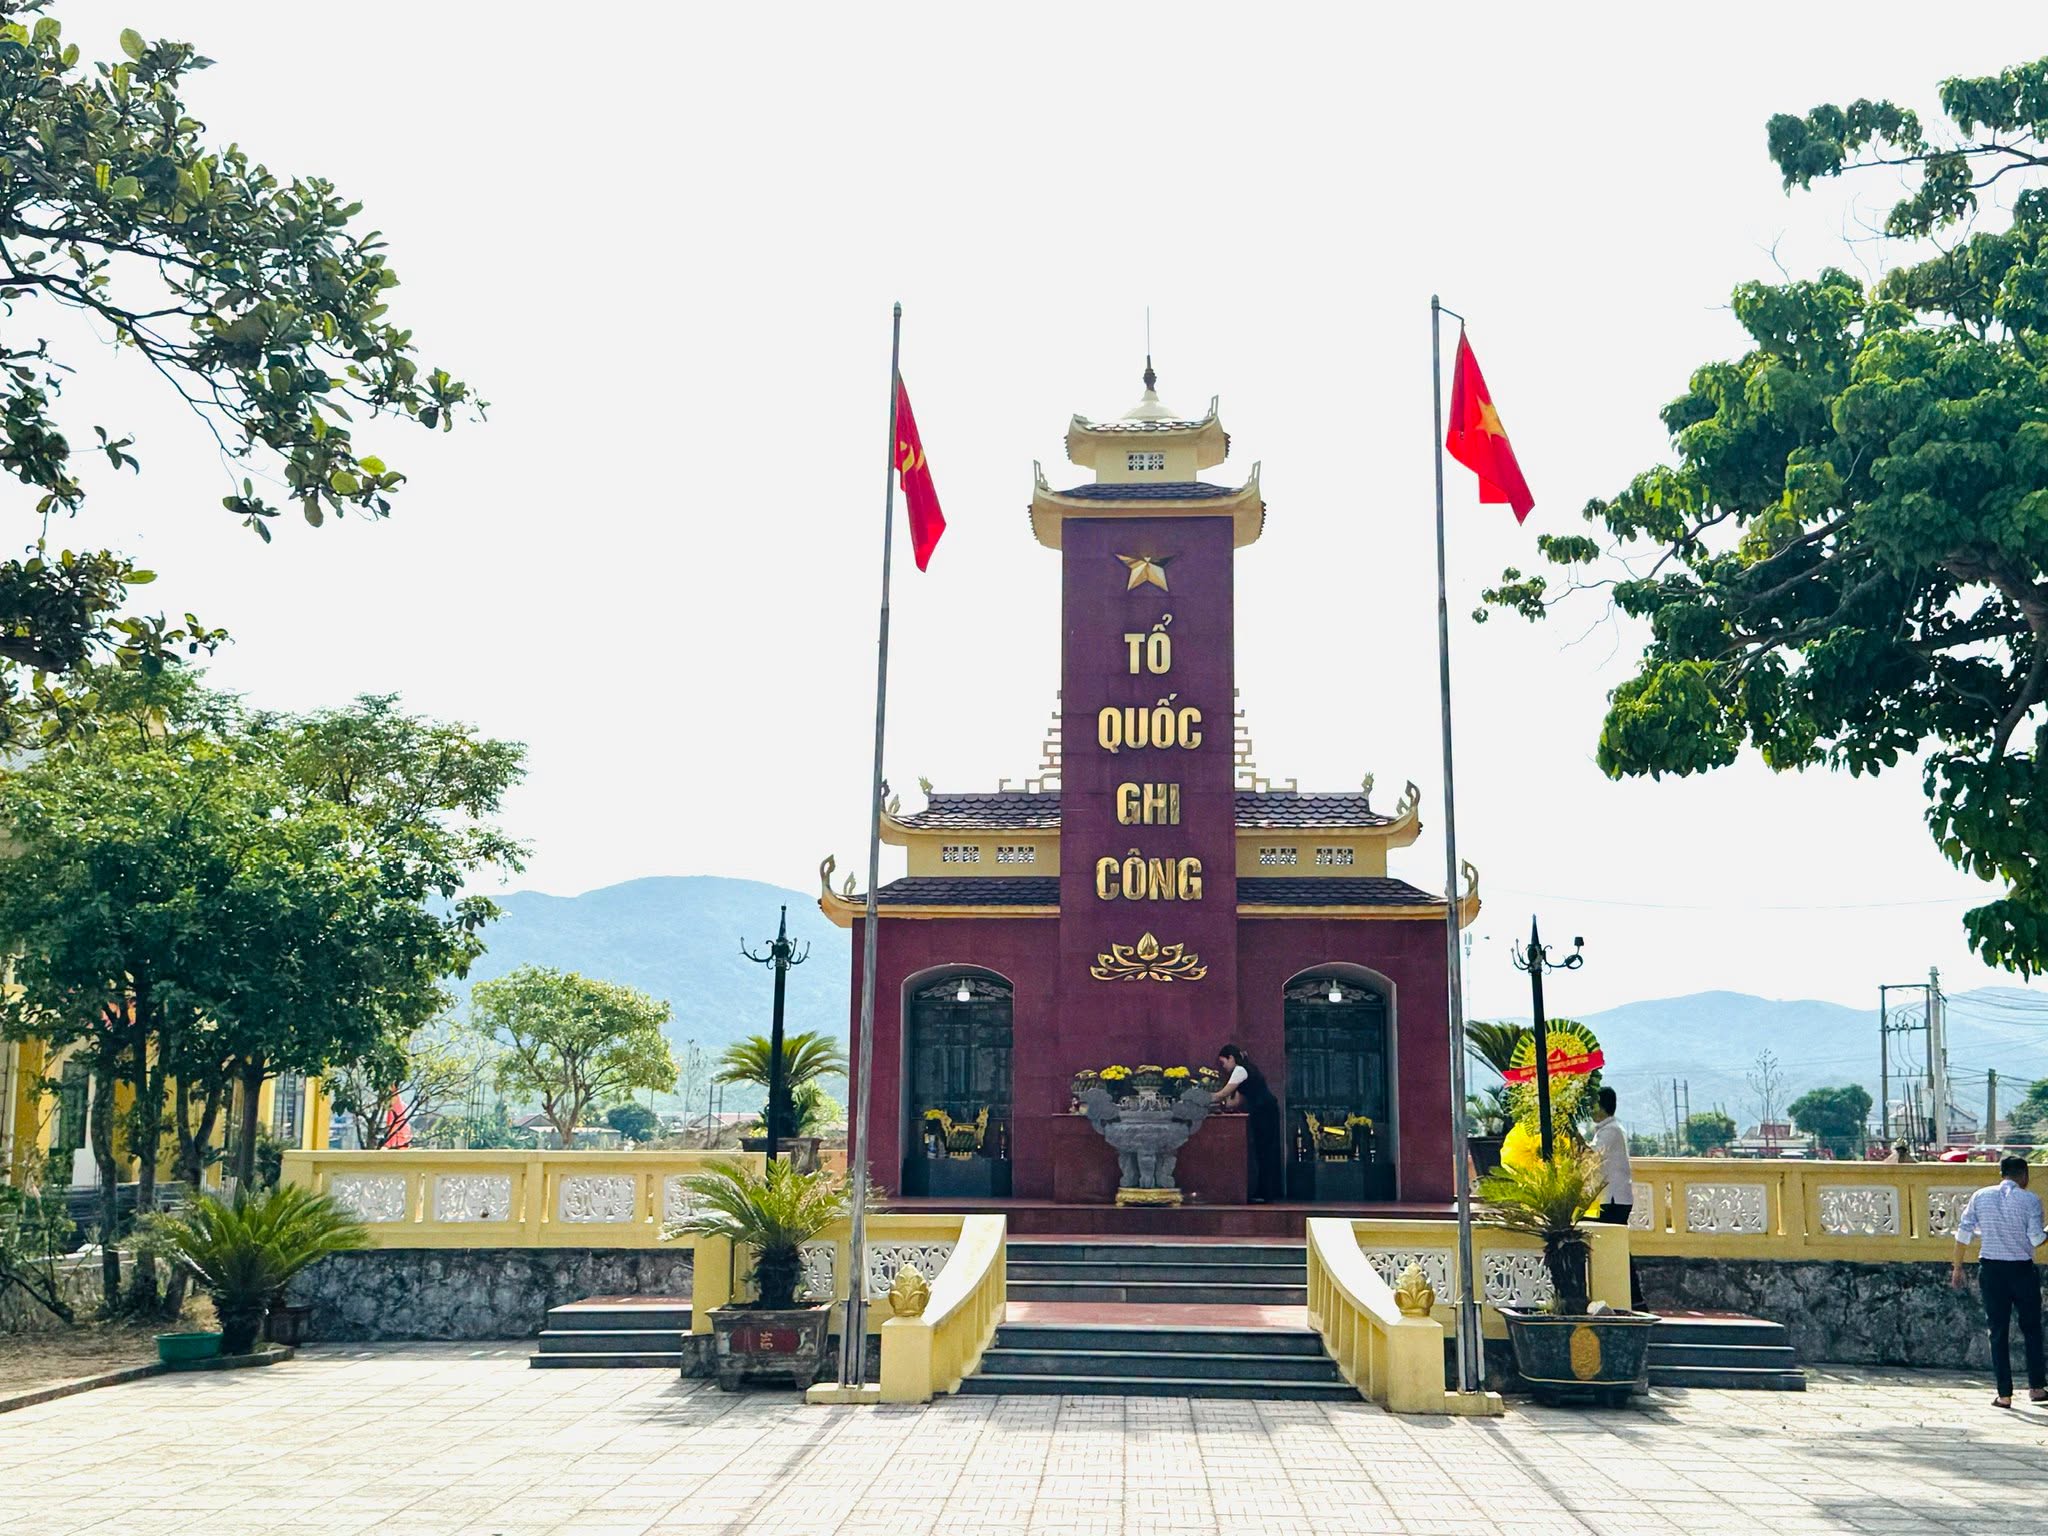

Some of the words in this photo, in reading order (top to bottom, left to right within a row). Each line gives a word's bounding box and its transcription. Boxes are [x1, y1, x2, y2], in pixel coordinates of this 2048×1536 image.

[1124, 613, 1172, 675] TỔ
[1098, 693, 1202, 753] QUỐC
[1116, 782, 1180, 825] GHI
[1096, 848, 1202, 901] CÔNG
